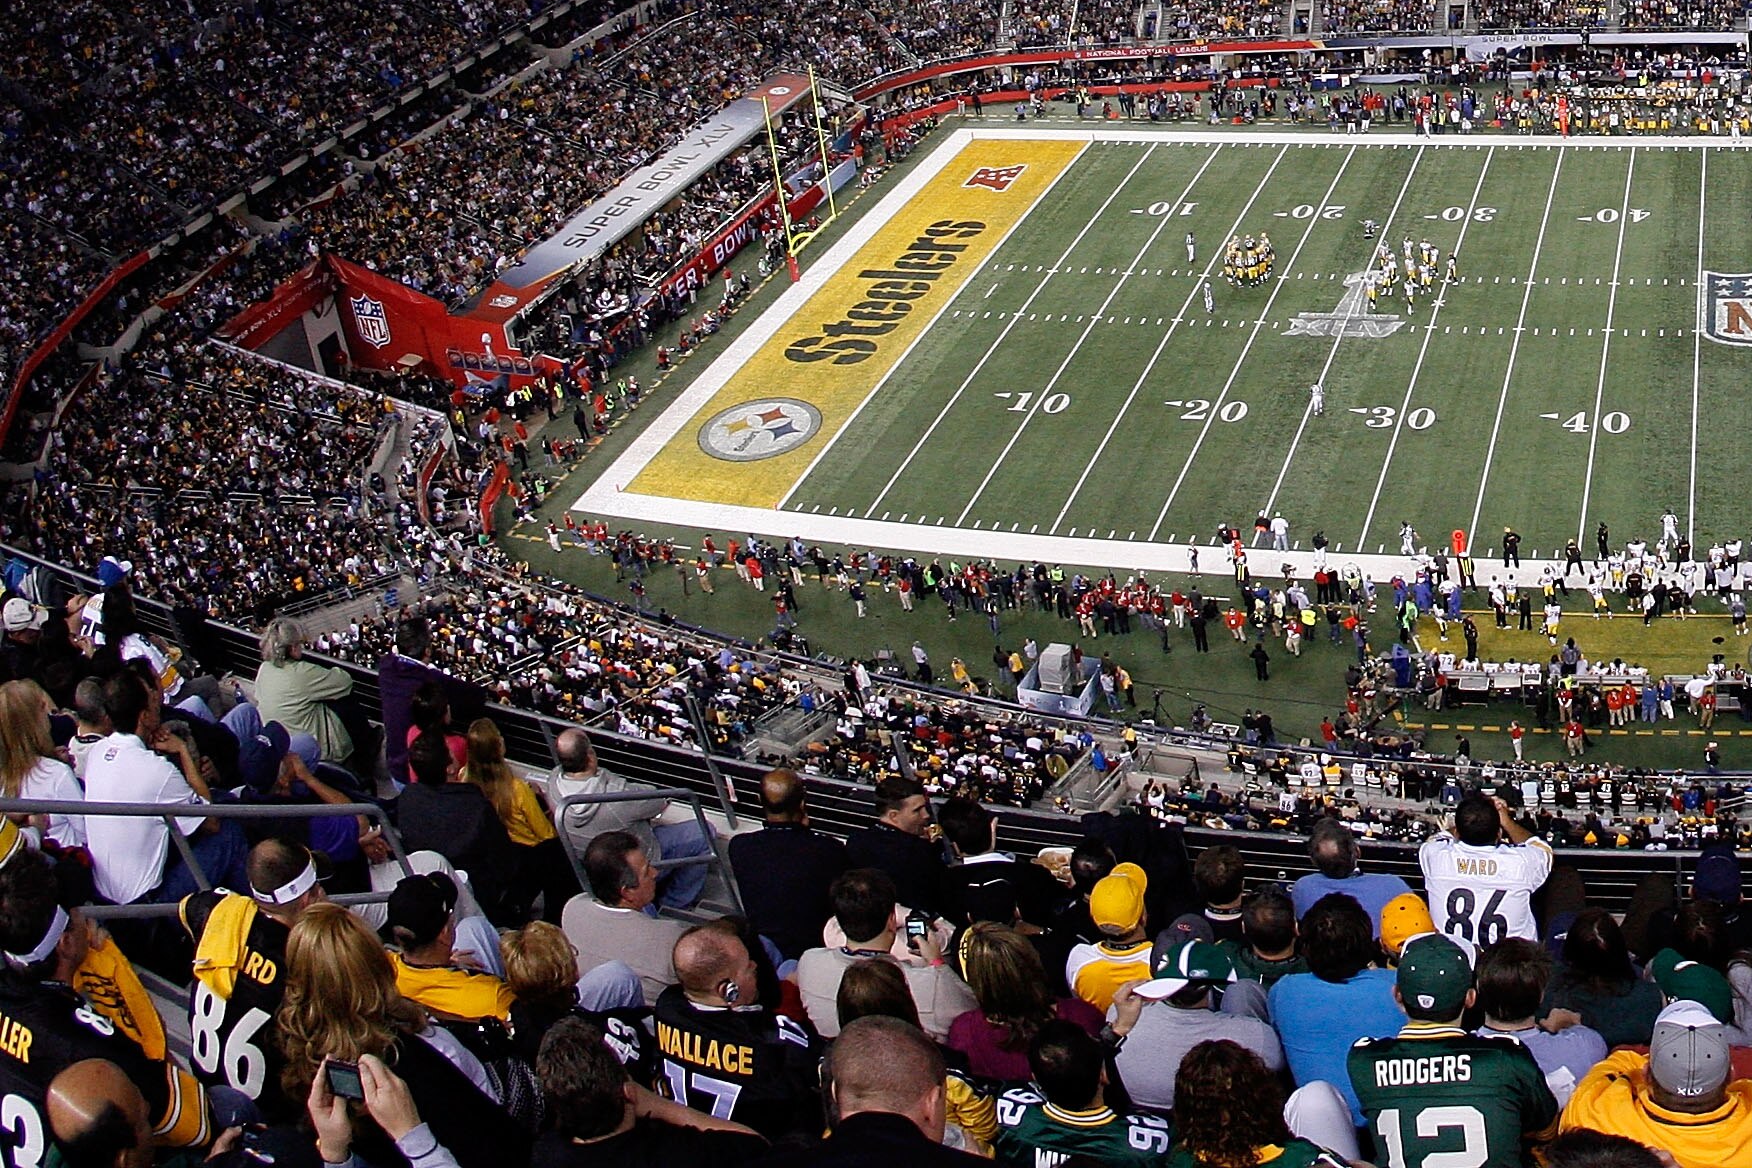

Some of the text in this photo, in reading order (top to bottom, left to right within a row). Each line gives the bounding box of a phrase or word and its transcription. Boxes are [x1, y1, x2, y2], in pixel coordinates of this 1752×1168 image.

[1086, 47, 1128, 58] NATIONAL
[1175, 44, 1209, 54] LEAGUE
[562, 122, 736, 250] SUPER BOWL XLV
[784, 219, 987, 366] Steelers
[358, 316, 387, 339] NFL
[1006, 390, 1072, 414] 10
[1180, 399, 1249, 423] 20
[1365, 406, 1437, 430] 30
[1561, 410, 1632, 434] 40
[1457, 858, 1498, 876] WARD
[1444, 887, 1508, 950] 86
[191, 980, 272, 1101] 86
[604, 1016, 641, 1065] 43
[657, 1020, 754, 1075] WALLACE
[1375, 1054, 1472, 1088] RODGERS
[663, 1057, 743, 1121] 17
[1676, 1086, 1704, 1097] XLV
[1375, 1105, 1490, 1168] 12
